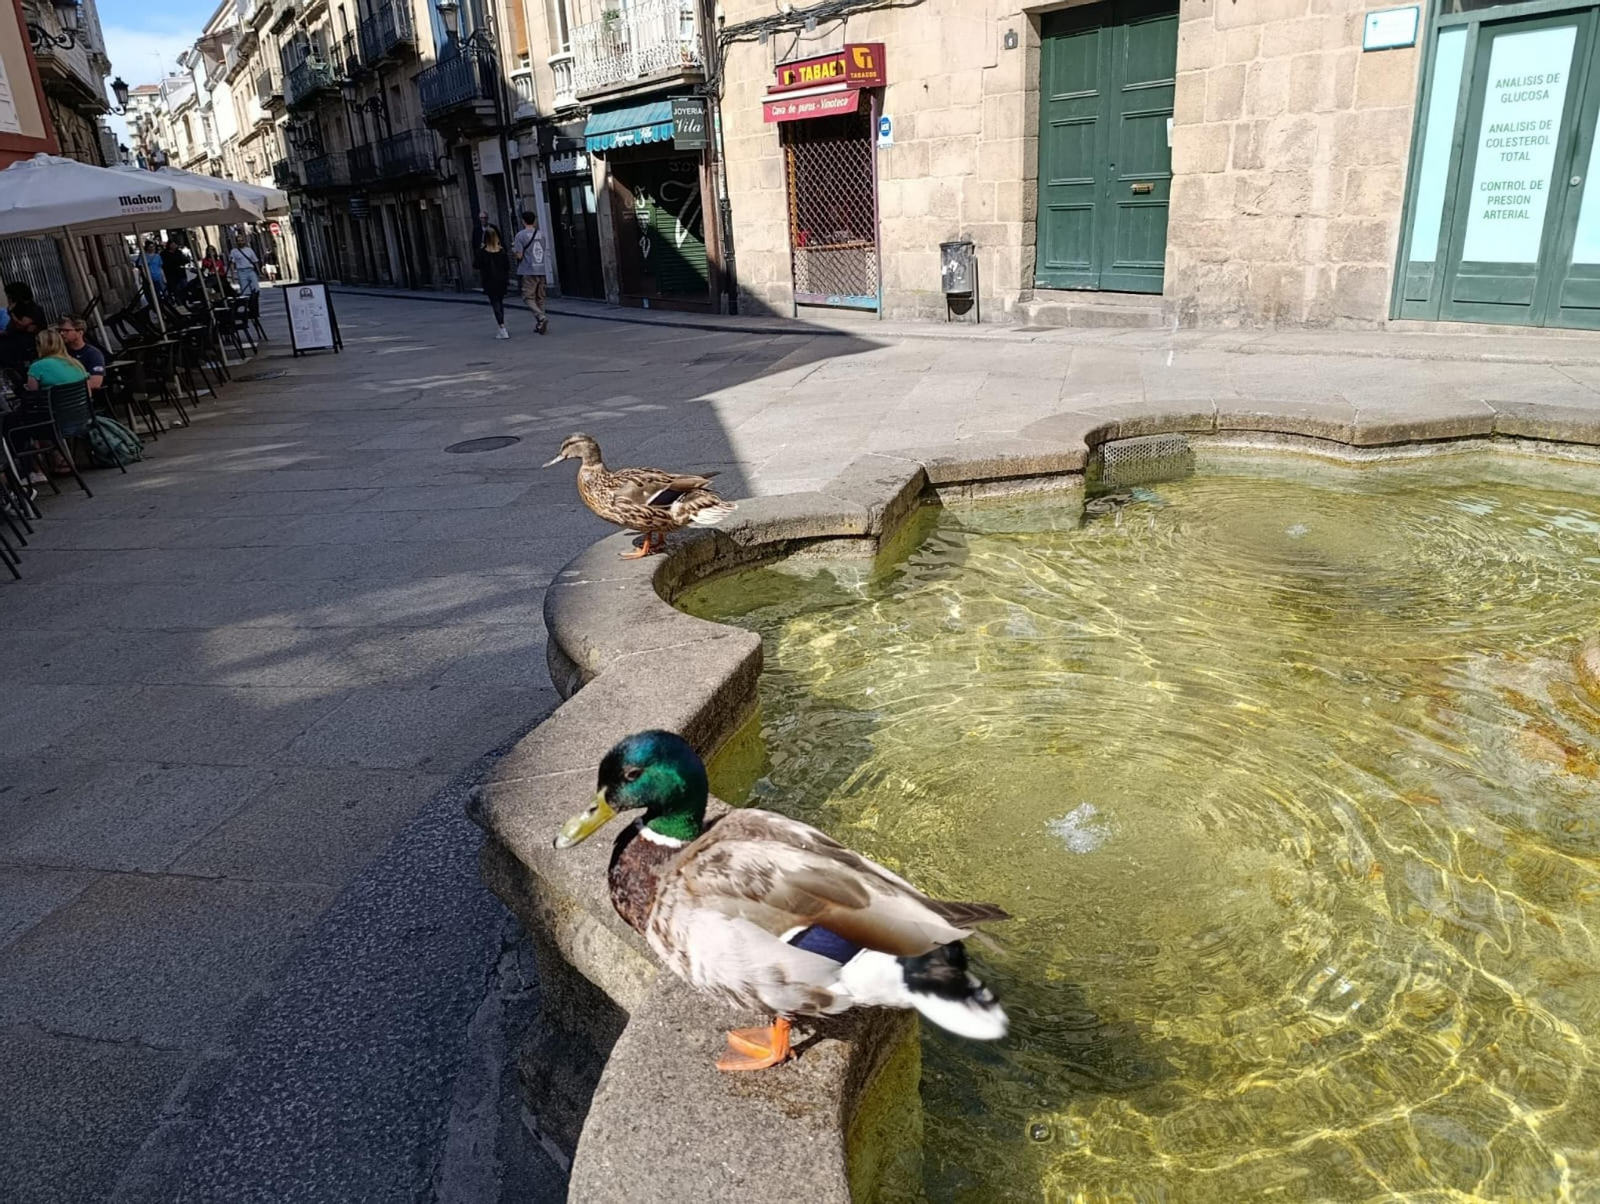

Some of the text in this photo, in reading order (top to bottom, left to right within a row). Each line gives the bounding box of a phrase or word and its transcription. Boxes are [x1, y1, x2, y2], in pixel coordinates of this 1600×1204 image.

[850, 71, 877, 79] TABACOS
[1495, 72, 1560, 89] ANALISIS DE
[1500, 89, 1549, 103] GLUCOSA
[673, 107, 703, 116] JOYERIA
[788, 104, 797, 113] de
[798, 102, 816, 115] puros
[820, 97, 849, 109] Vinoteca
[676, 119, 704, 133] Vila
[1488, 119, 1552, 134] ANALISIS DE
[1485, 135, 1551, 149] COLESTEROL
[1500, 151, 1531, 162] TOTAL
[1480, 179, 1544, 192] CONTROL DE
[118, 194, 162, 206] Mahou
[1487, 195, 1531, 206] PRESION
[1482, 209, 1531, 220] ARTERIAL
